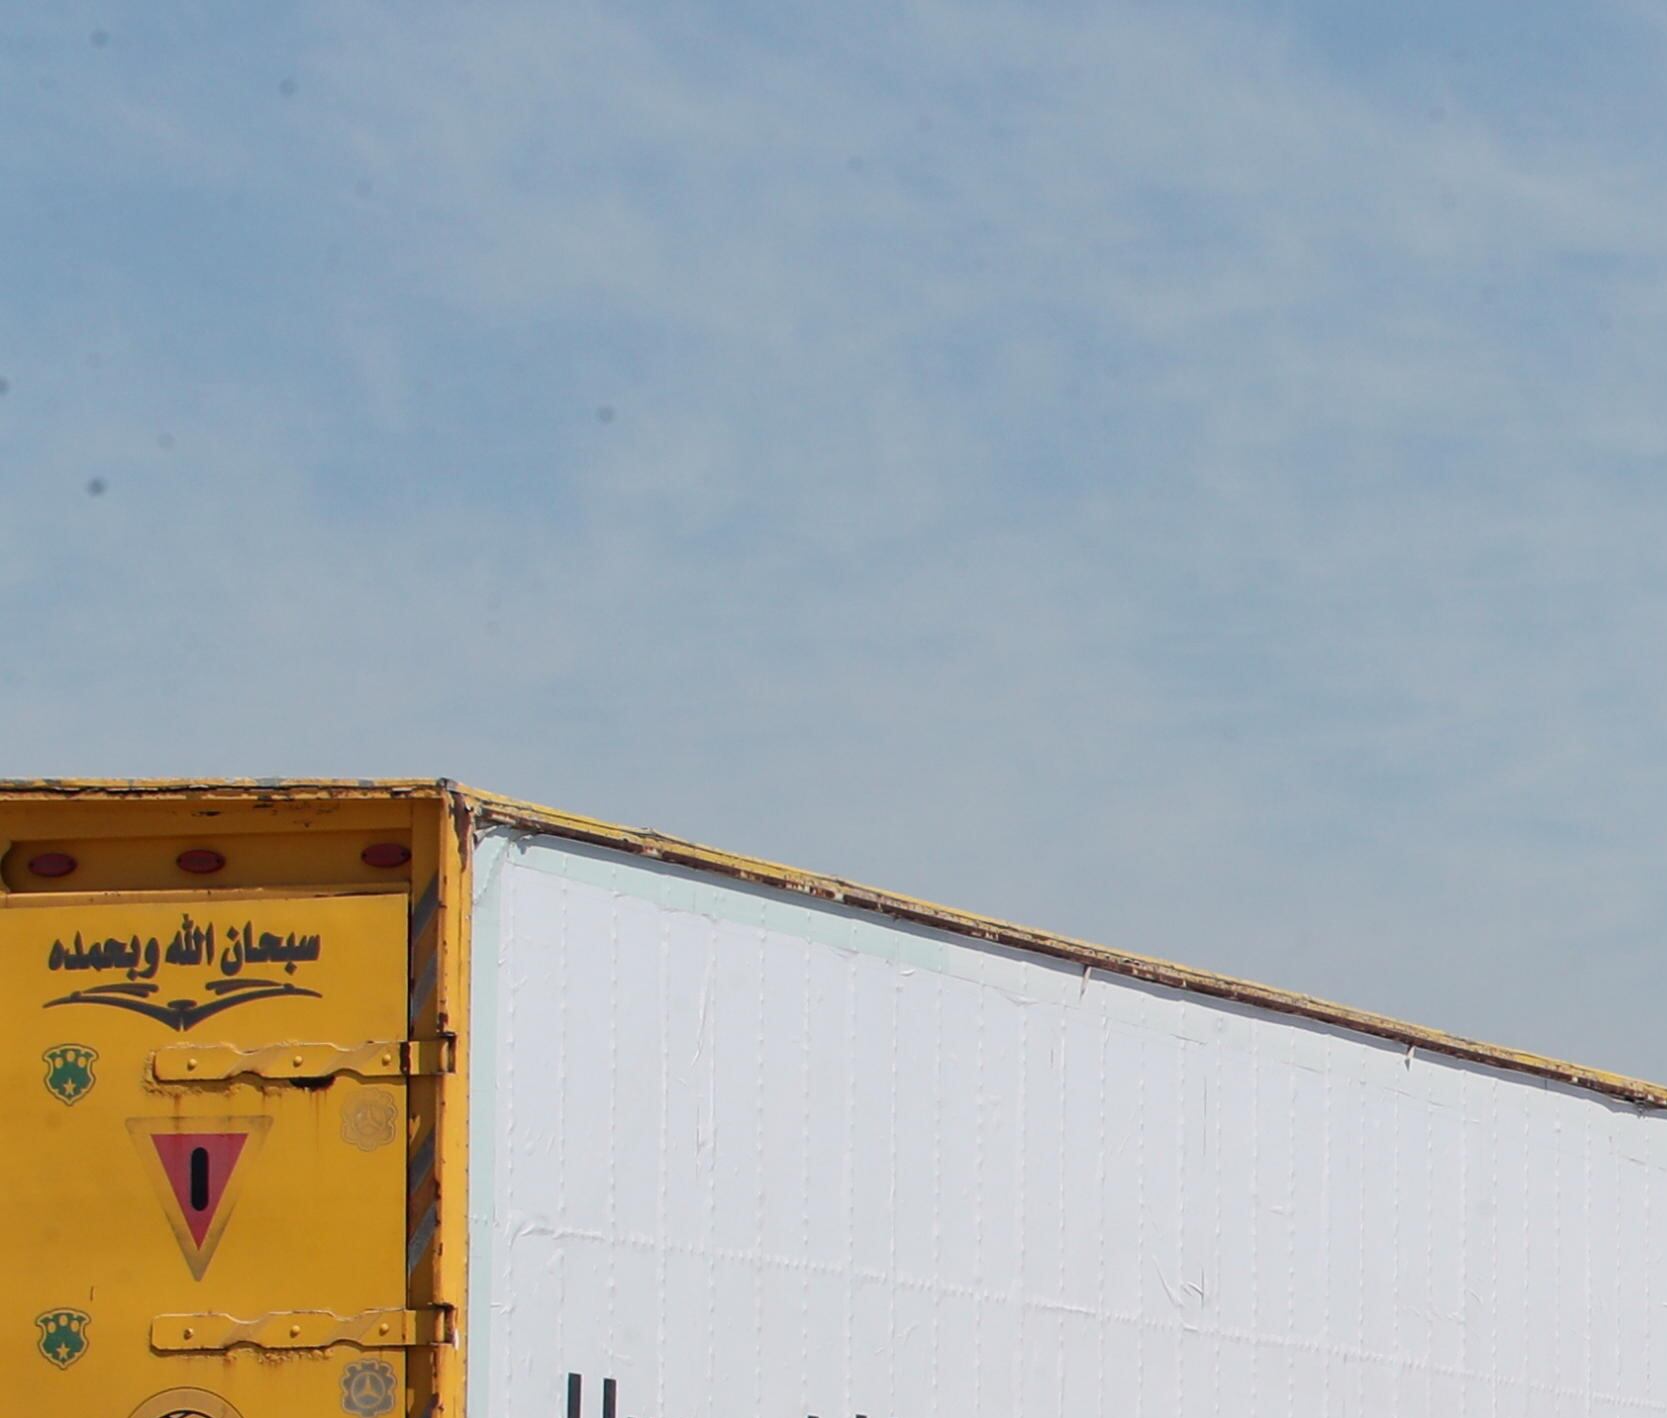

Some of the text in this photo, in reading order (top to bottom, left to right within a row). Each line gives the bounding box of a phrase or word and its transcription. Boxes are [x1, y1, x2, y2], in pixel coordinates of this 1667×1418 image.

[48, 913, 322, 981] سبحان الله وبحمده
